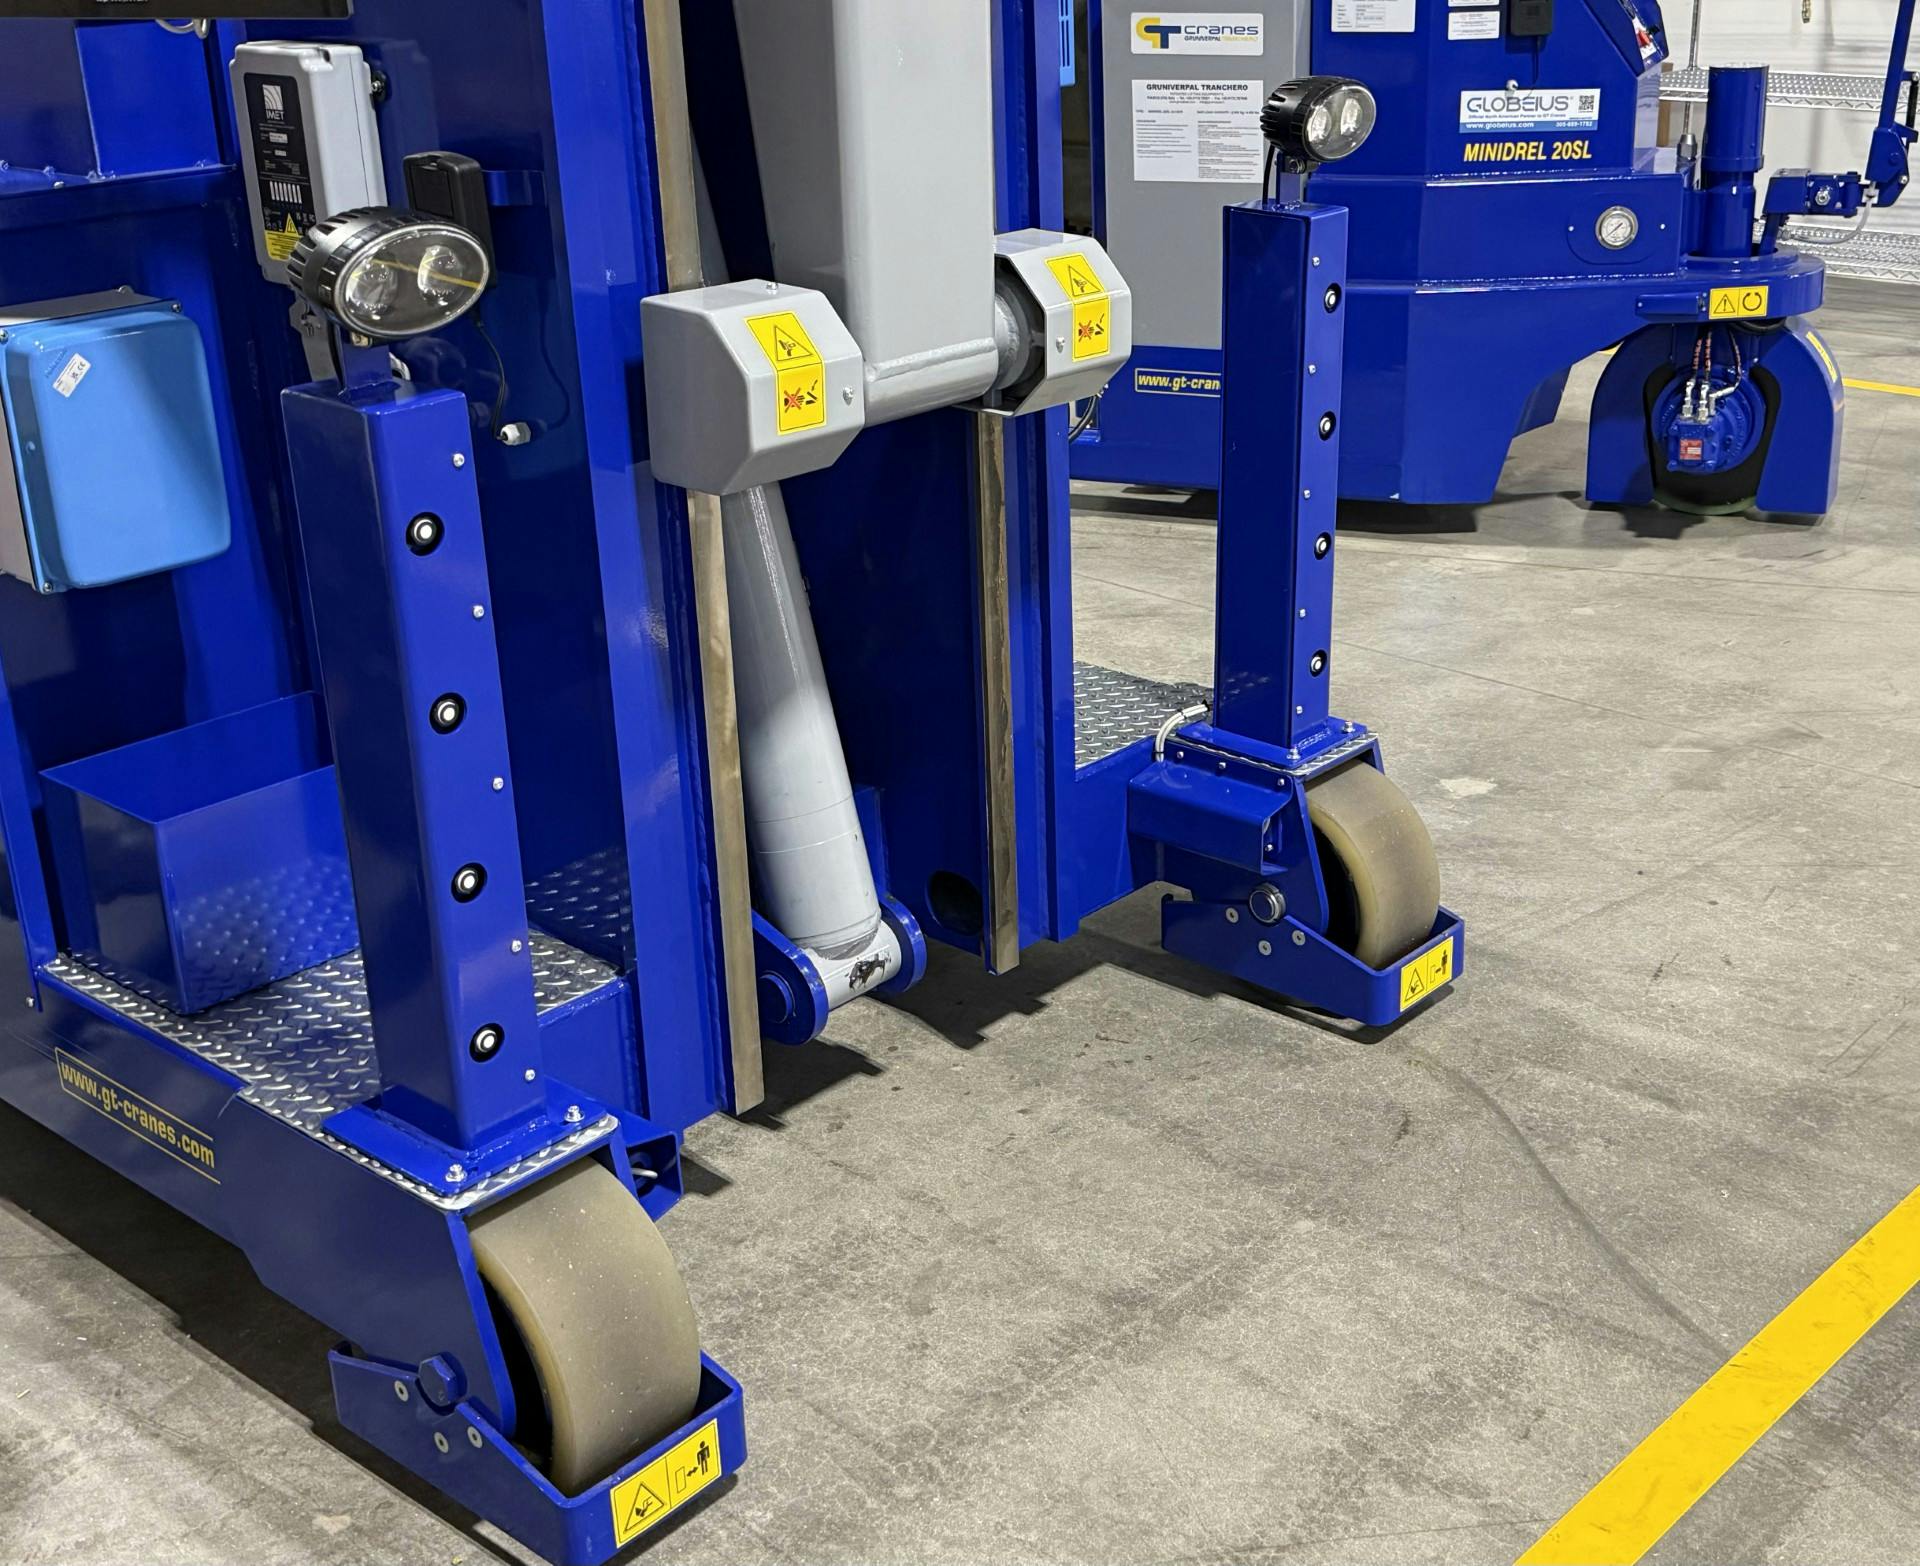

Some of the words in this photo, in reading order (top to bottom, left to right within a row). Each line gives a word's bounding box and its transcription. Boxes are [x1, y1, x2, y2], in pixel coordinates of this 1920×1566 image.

[1184, 25, 1259, 35] cranes
[1146, 83, 1199, 91] GRUNIVERPAL
[1466, 95, 1570, 113] GLOBEIUS
[1463, 141, 1548, 162] MINIDREL
[1551, 139, 1593, 161] 20SL
[60, 1060, 216, 1169] www.gt-cranes.com
